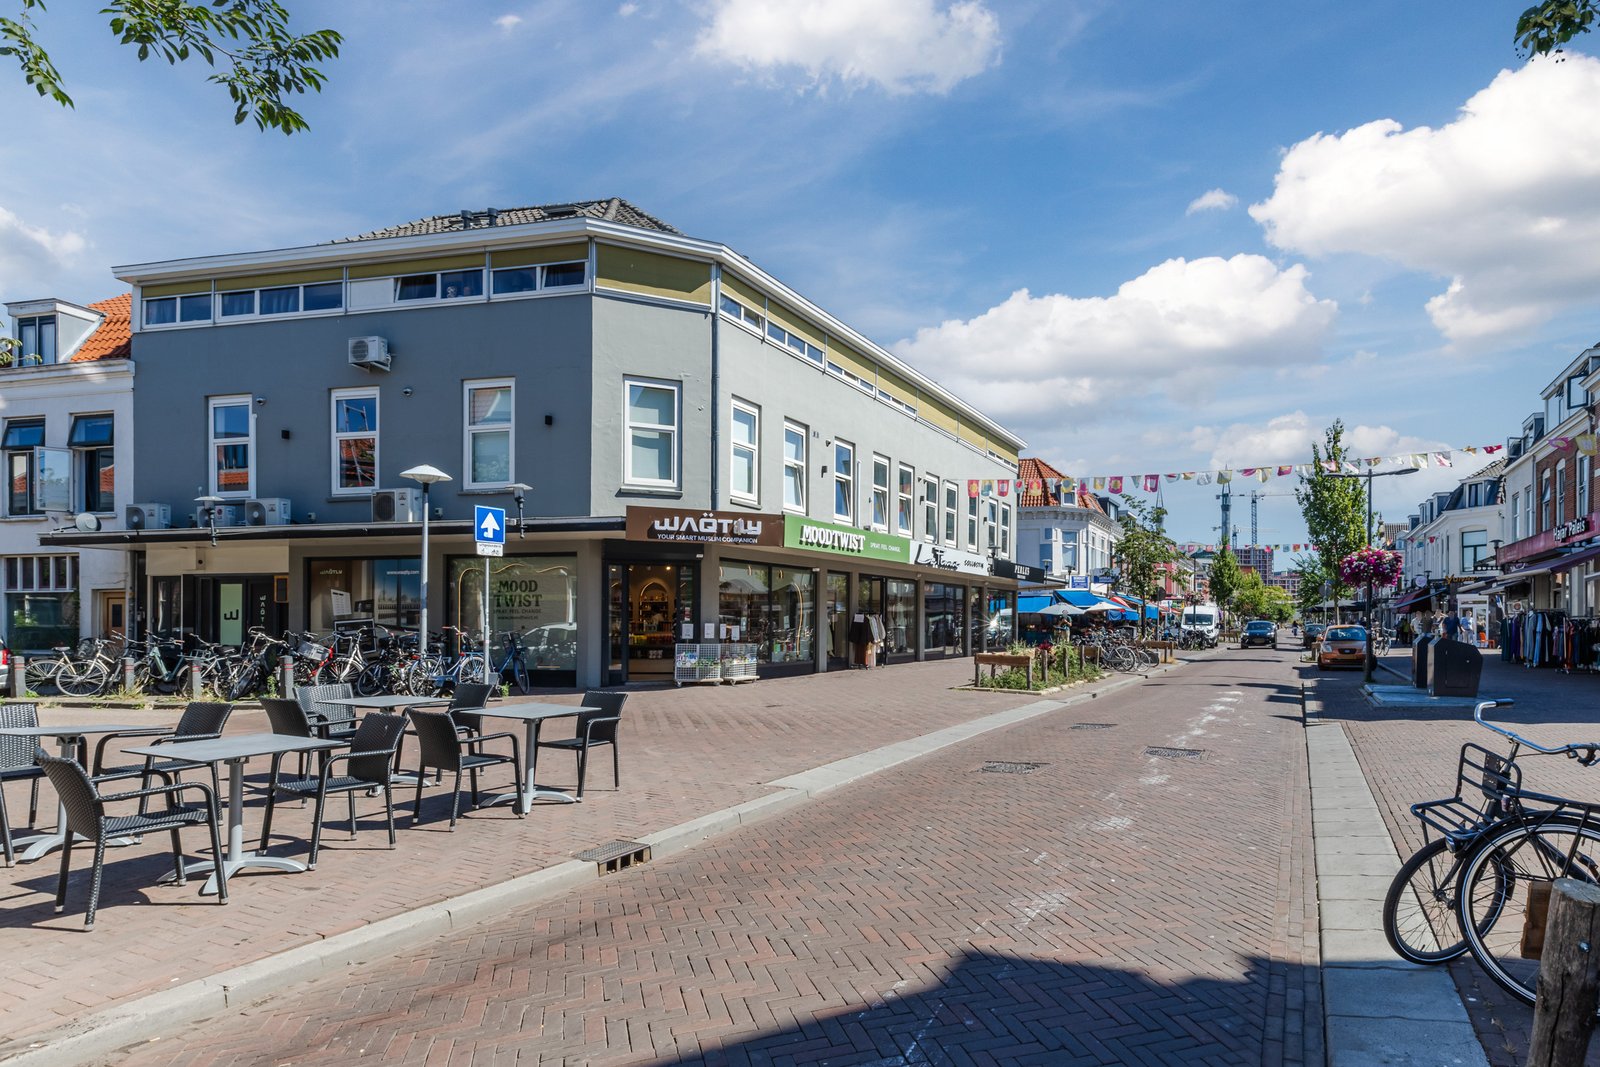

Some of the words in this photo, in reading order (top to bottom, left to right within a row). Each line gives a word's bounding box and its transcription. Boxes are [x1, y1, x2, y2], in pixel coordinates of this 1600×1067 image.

[722, 536, 758, 544] COMPANION
[801, 525, 866, 551] MOODTWIST
[498, 580, 538, 593] MOOD
[493, 594, 543, 607] TWIST
